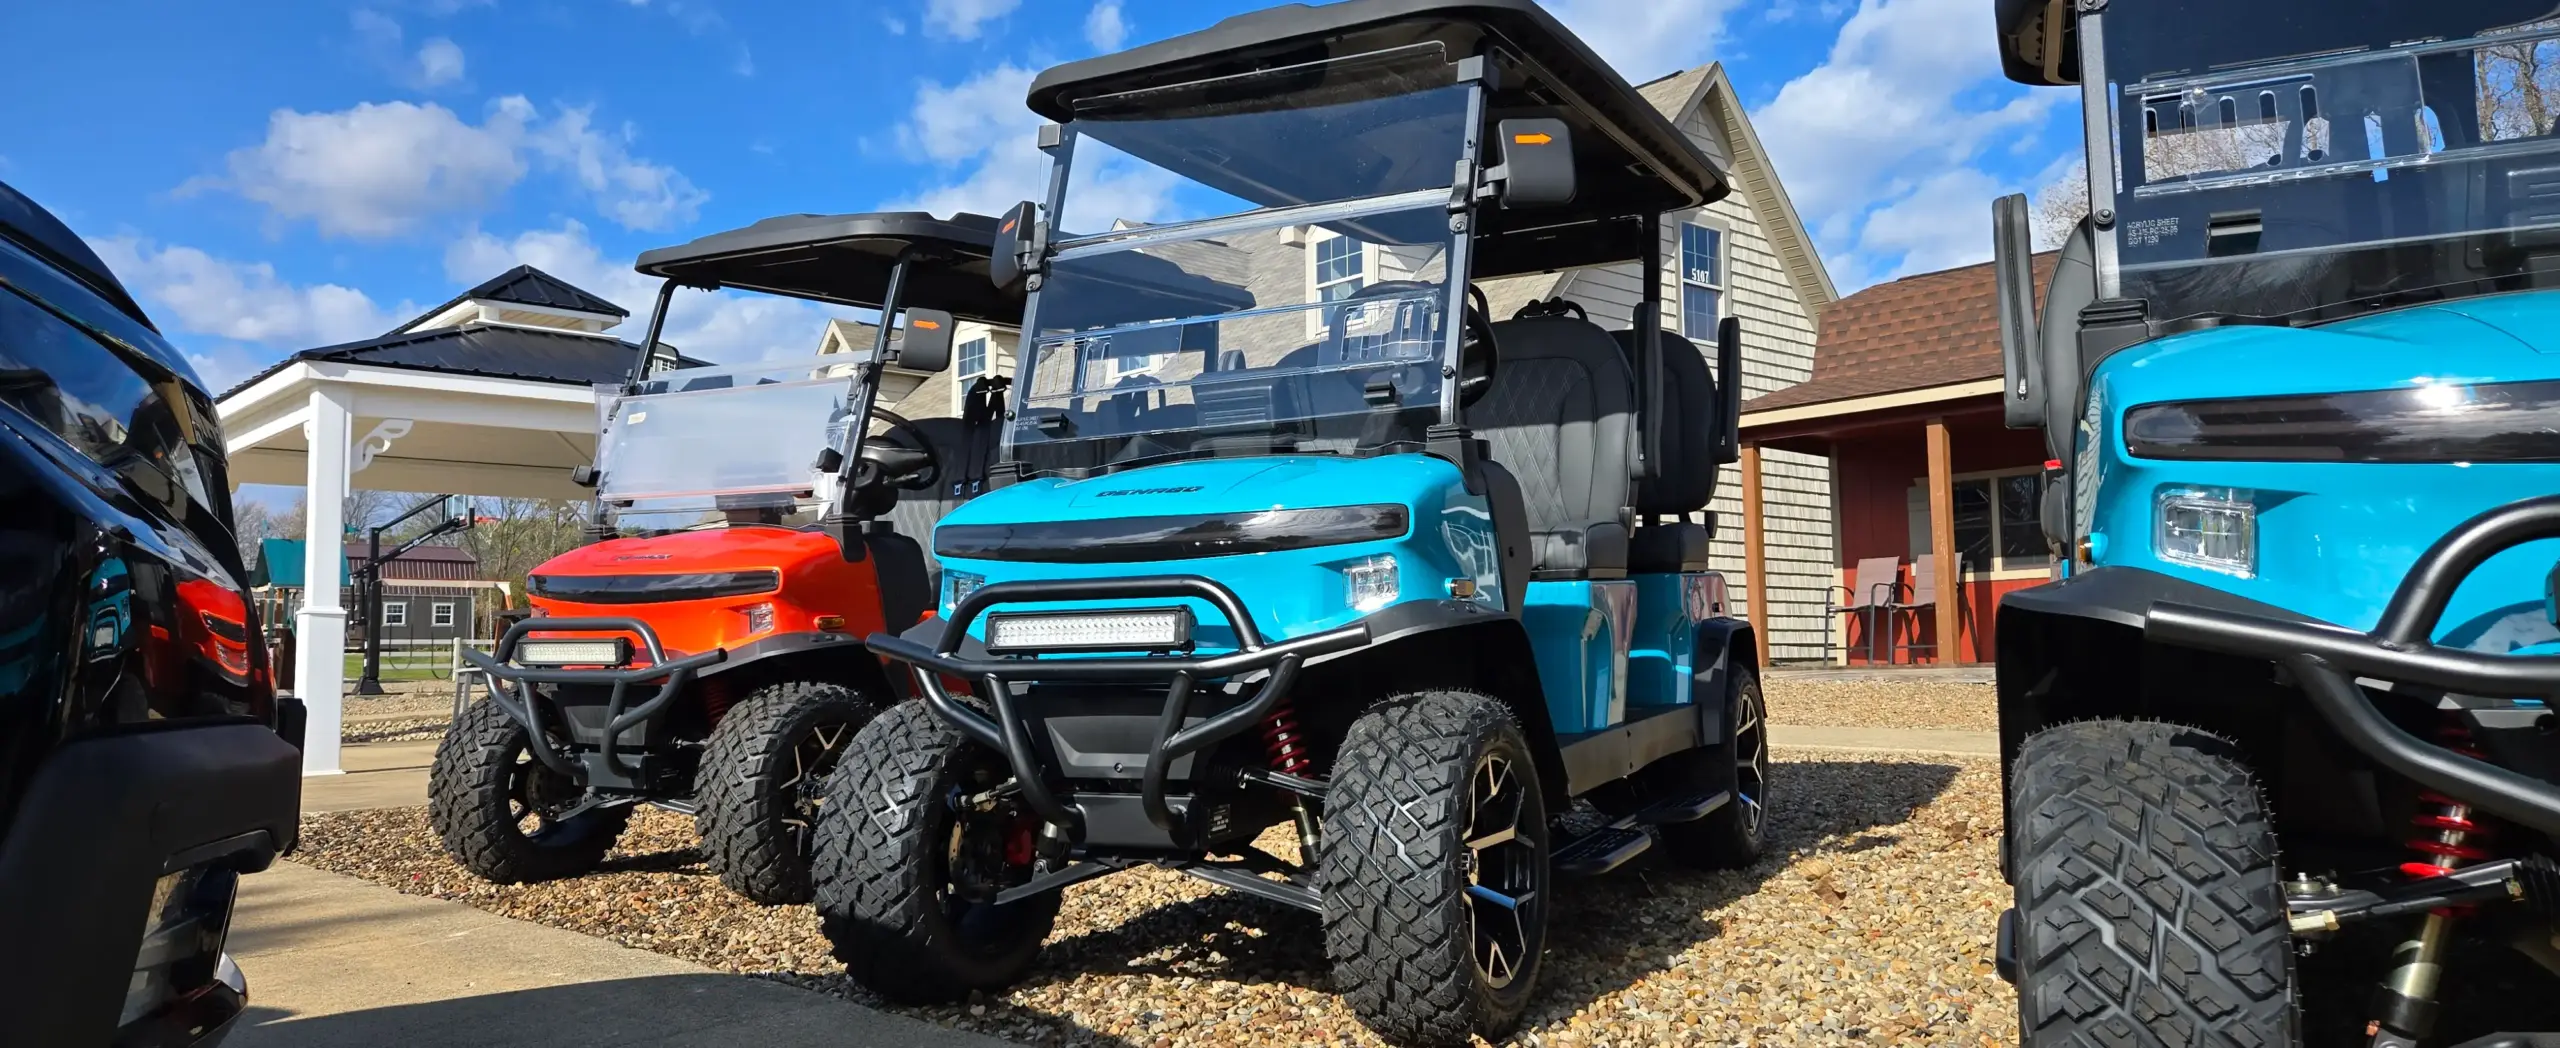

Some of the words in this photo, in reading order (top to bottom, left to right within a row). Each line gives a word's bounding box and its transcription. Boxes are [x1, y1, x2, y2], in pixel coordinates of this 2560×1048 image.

[2126, 219, 2156, 229] ACRYLIC
[2157, 217, 2179, 227] SHEET
[2128, 237, 2142, 245] DOT
[1691, 267, 1709, 283] 5107
